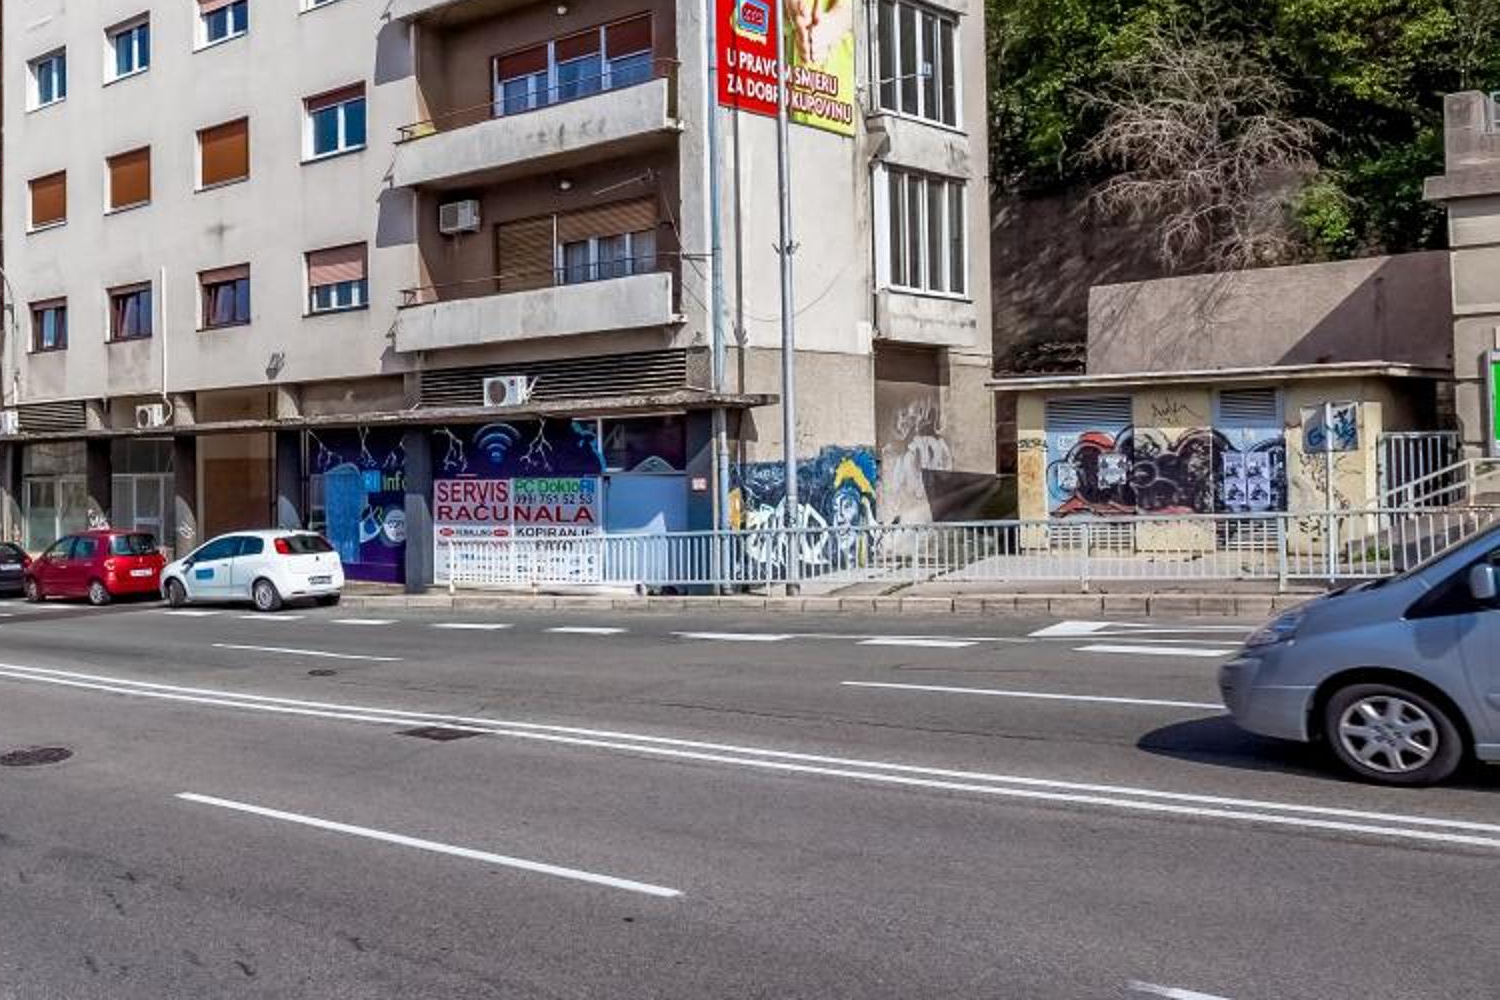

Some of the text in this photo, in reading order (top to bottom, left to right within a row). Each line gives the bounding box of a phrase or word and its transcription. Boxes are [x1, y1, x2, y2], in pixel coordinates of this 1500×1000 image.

[727, 47, 736, 67] U
[727, 73, 745, 96] ZA
[791, 91, 853, 123] KUPOVINU
[437, 481, 509, 503] SERVIS
[515, 479, 534, 493] PC
[437, 502, 595, 523] RAČUNALA
